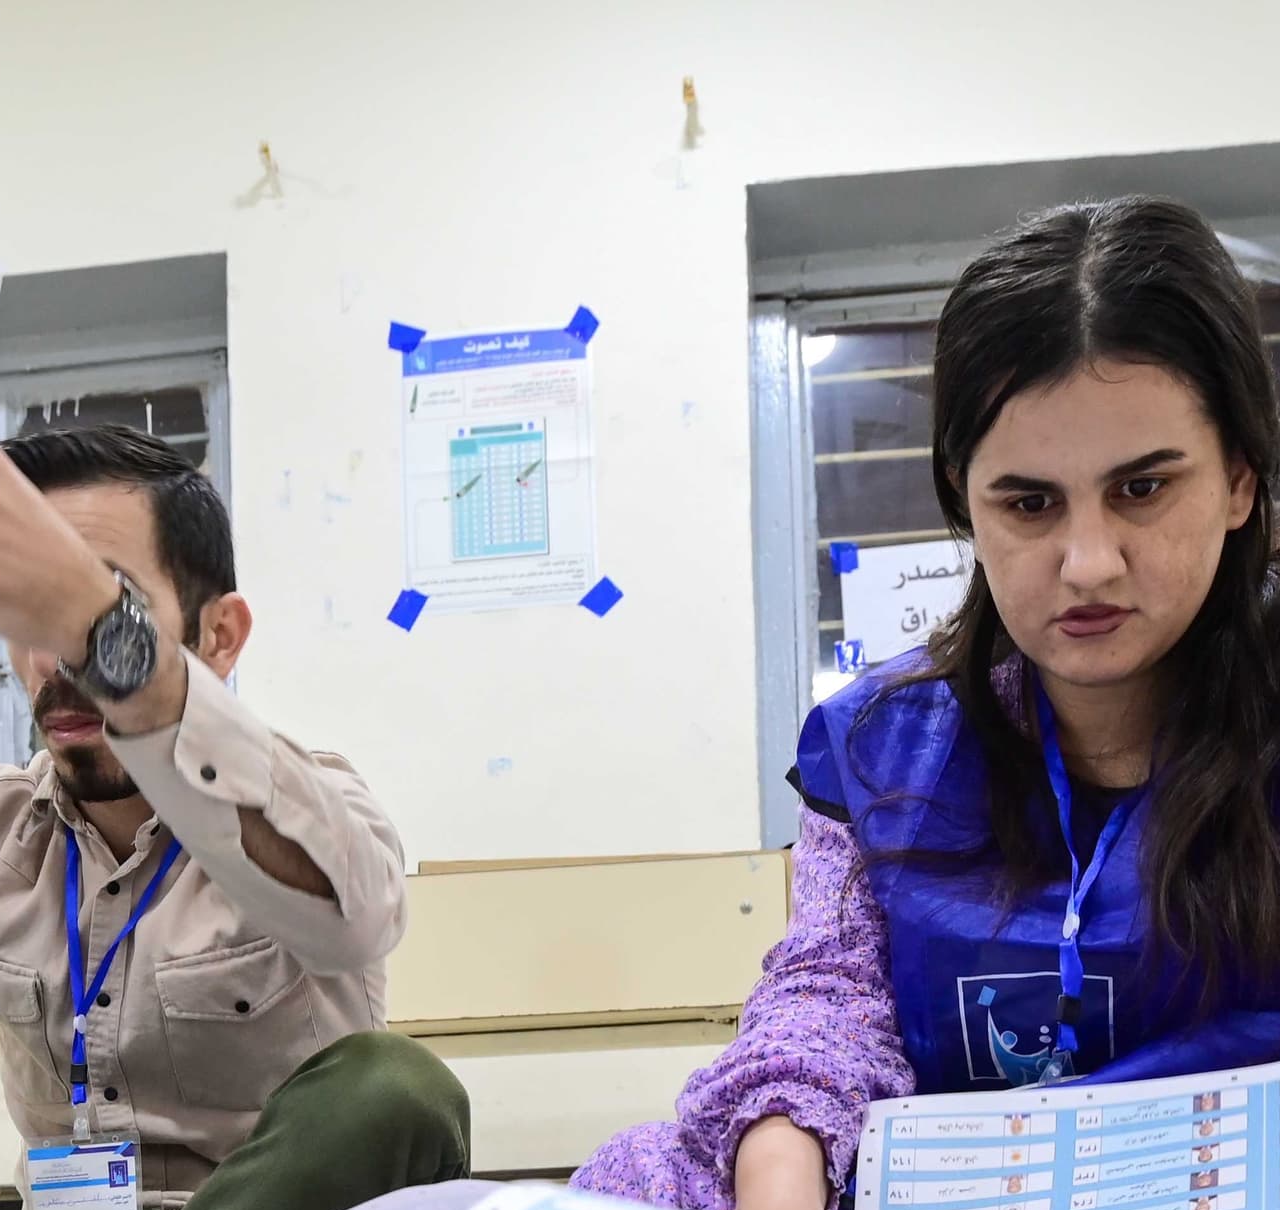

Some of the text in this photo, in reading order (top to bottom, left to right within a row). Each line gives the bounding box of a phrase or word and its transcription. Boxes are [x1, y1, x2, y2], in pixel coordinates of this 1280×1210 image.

[463, 335, 531, 354] كيف تصوت
[891, 564, 967, 589] مصدر
[892, 1156, 911, 1165] ١٦٩
[889, 1190, 910, 1199] ١٦٧
